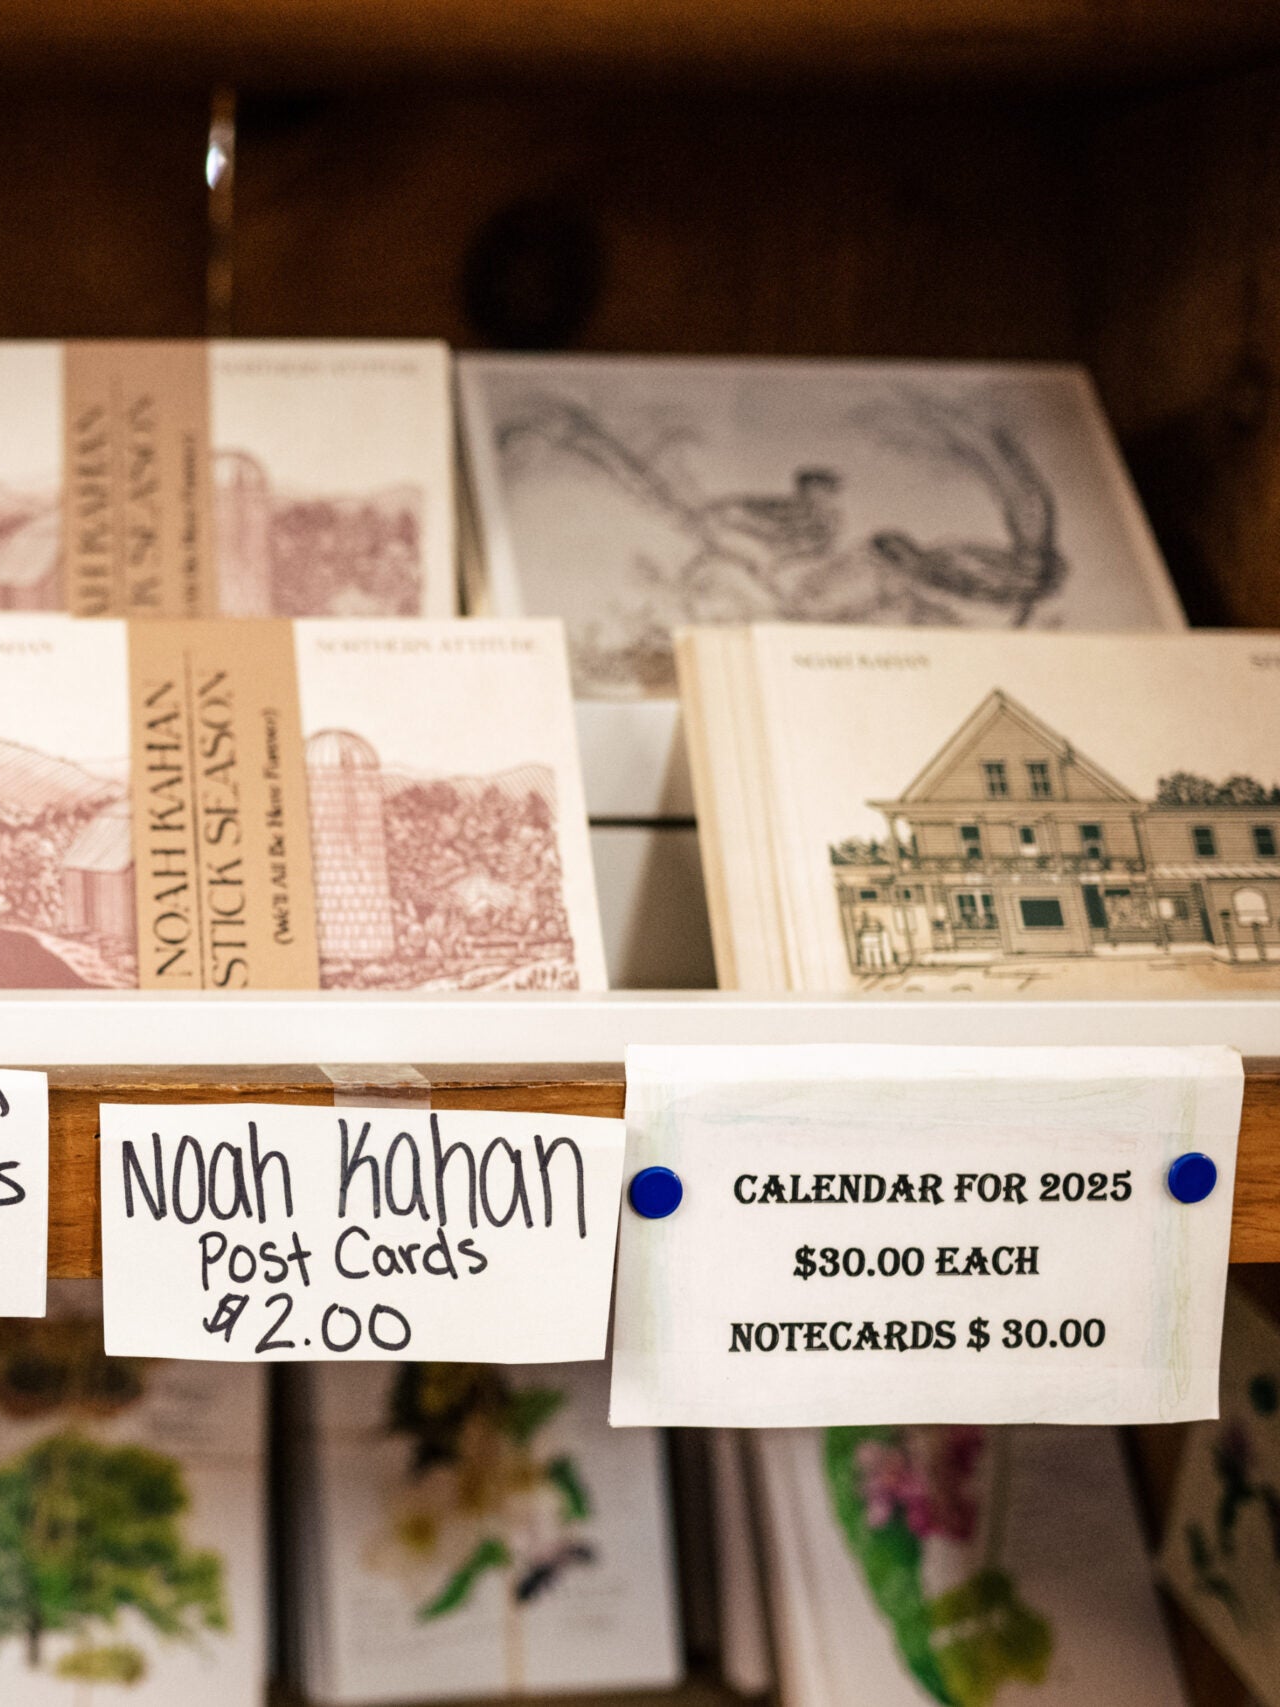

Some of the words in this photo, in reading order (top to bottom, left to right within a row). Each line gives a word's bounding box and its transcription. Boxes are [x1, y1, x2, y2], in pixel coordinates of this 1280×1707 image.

[144, 679, 187, 832] KAHAN
[197, 670, 243, 847] SEASON
[150, 848, 193, 978] NOAH
[207, 857, 249, 990] STICK
[122, 1121, 294, 1224] Noah
[338, 1113, 586, 1238] Kahan
[733, 1173, 945, 1206] CALENDAR
[954, 1172, 1029, 1205] FOR
[1039, 1170, 1133, 1202] 2025
[199, 1232, 311, 1290] Post
[335, 1225, 488, 1279] Cards
[793, 1244, 925, 1280] $30.00
[934, 1245, 1040, 1276] EACH
[728, 1319, 957, 1353] NOTECARDS
